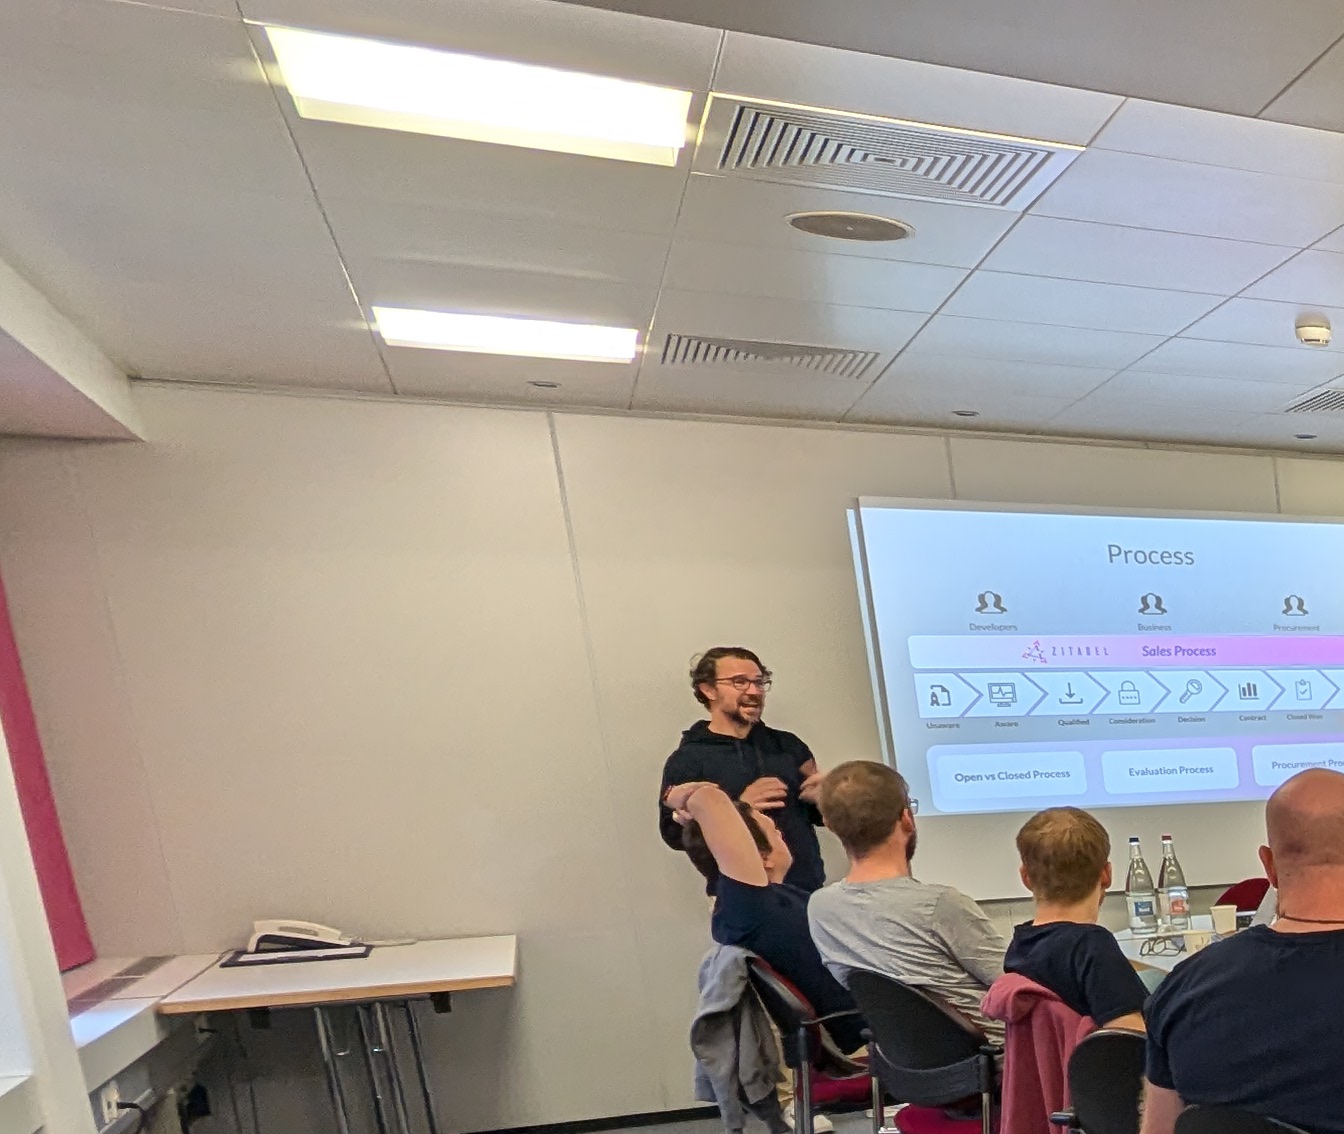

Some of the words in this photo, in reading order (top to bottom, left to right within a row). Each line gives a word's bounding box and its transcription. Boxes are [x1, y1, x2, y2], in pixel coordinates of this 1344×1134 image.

[1107, 543, 1195, 566] Process
[968, 622, 1018, 632] Developers
[1137, 623, 1172, 632] Business
[1273, 624, 1320, 632] Procurement
[1051, 646, 1109, 657] ZITADEL
[1141, 645, 1172, 657] Sales
[1174, 644, 1217, 657] Process
[1058, 718, 1090, 727] Qualified
[1108, 717, 1156, 725] Consideration
[1177, 716, 1206, 724] Decision
[1239, 714, 1267, 722] Contract
[1128, 765, 1178, 777] Evaluation
[1179, 763, 1214, 775] Process
[1271, 760, 1326, 770] Procurement
[954, 772, 983, 784] Open
[997, 770, 1031, 781] Closed
[1033, 768, 1071, 779] Process
